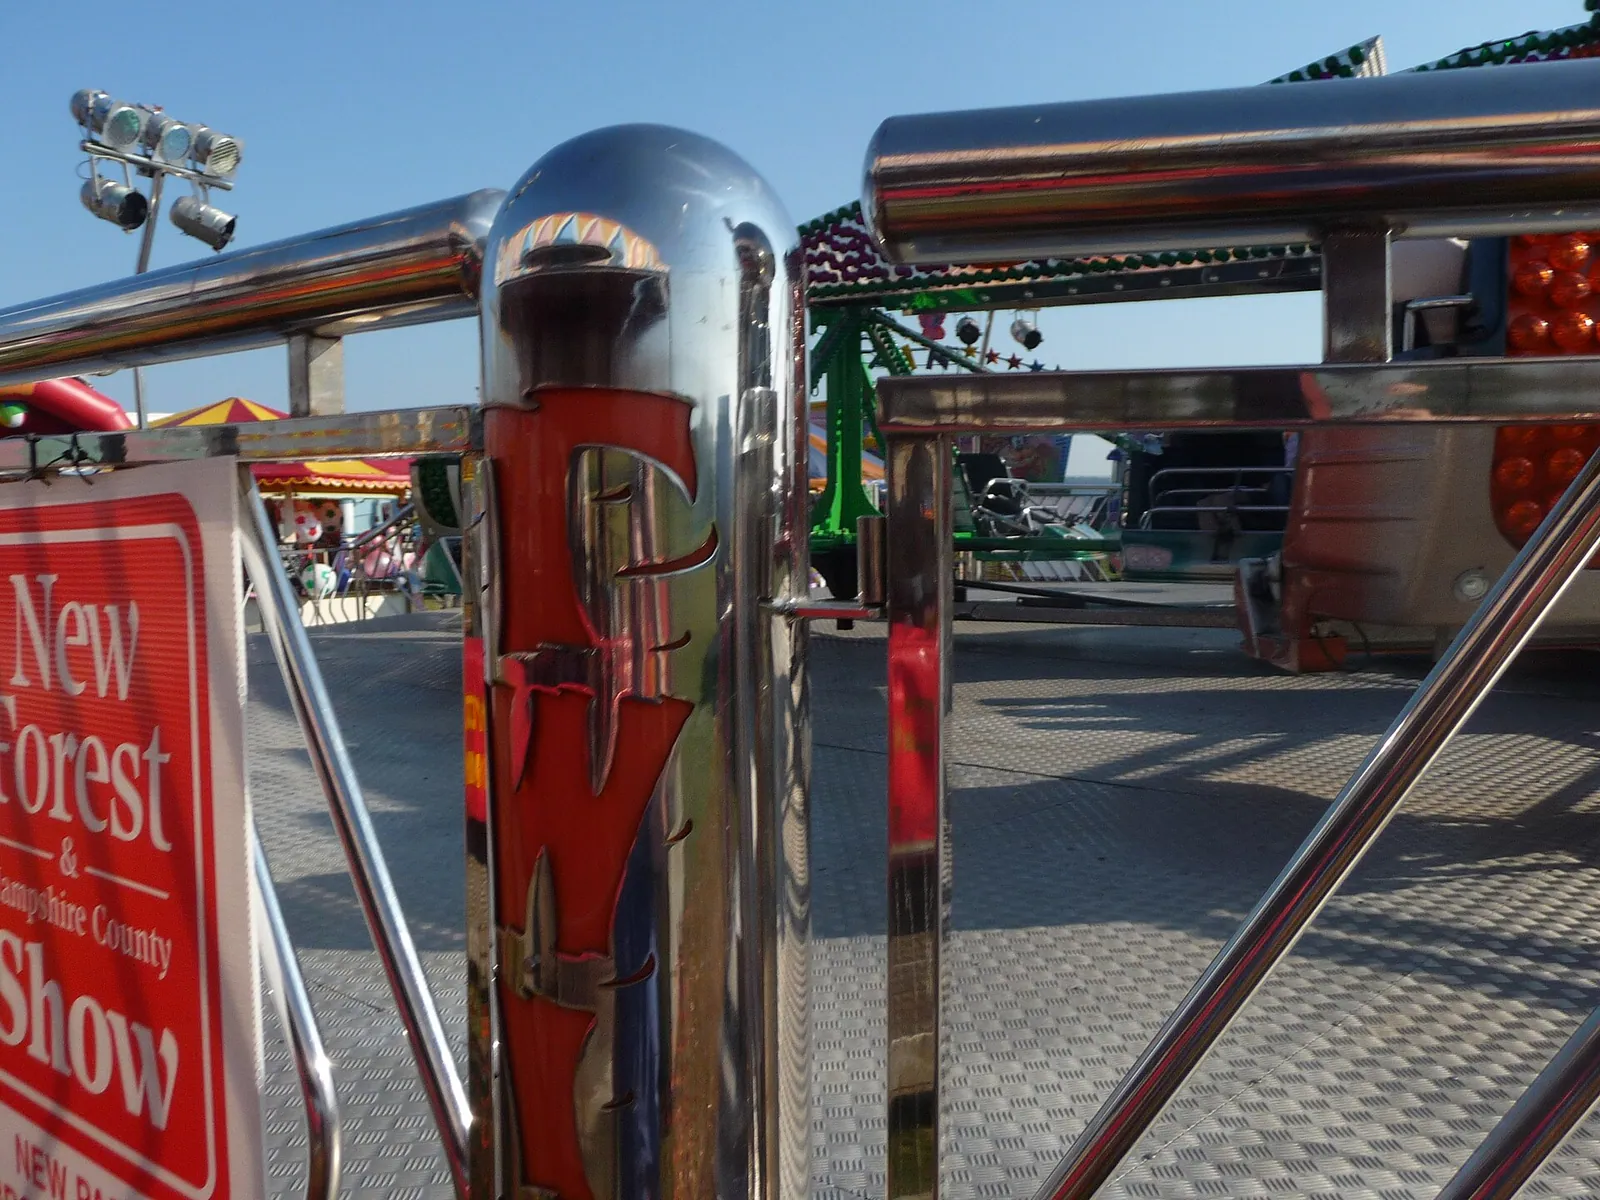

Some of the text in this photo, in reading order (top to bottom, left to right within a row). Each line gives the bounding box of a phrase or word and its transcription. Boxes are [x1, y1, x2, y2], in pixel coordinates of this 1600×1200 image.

[9, 573, 139, 700] New
[59, 836, 80, 880] &
[0, 867, 173, 981] ampshire County
[0, 928, 179, 1131] Show
[15, 1133, 67, 1200] NEW
